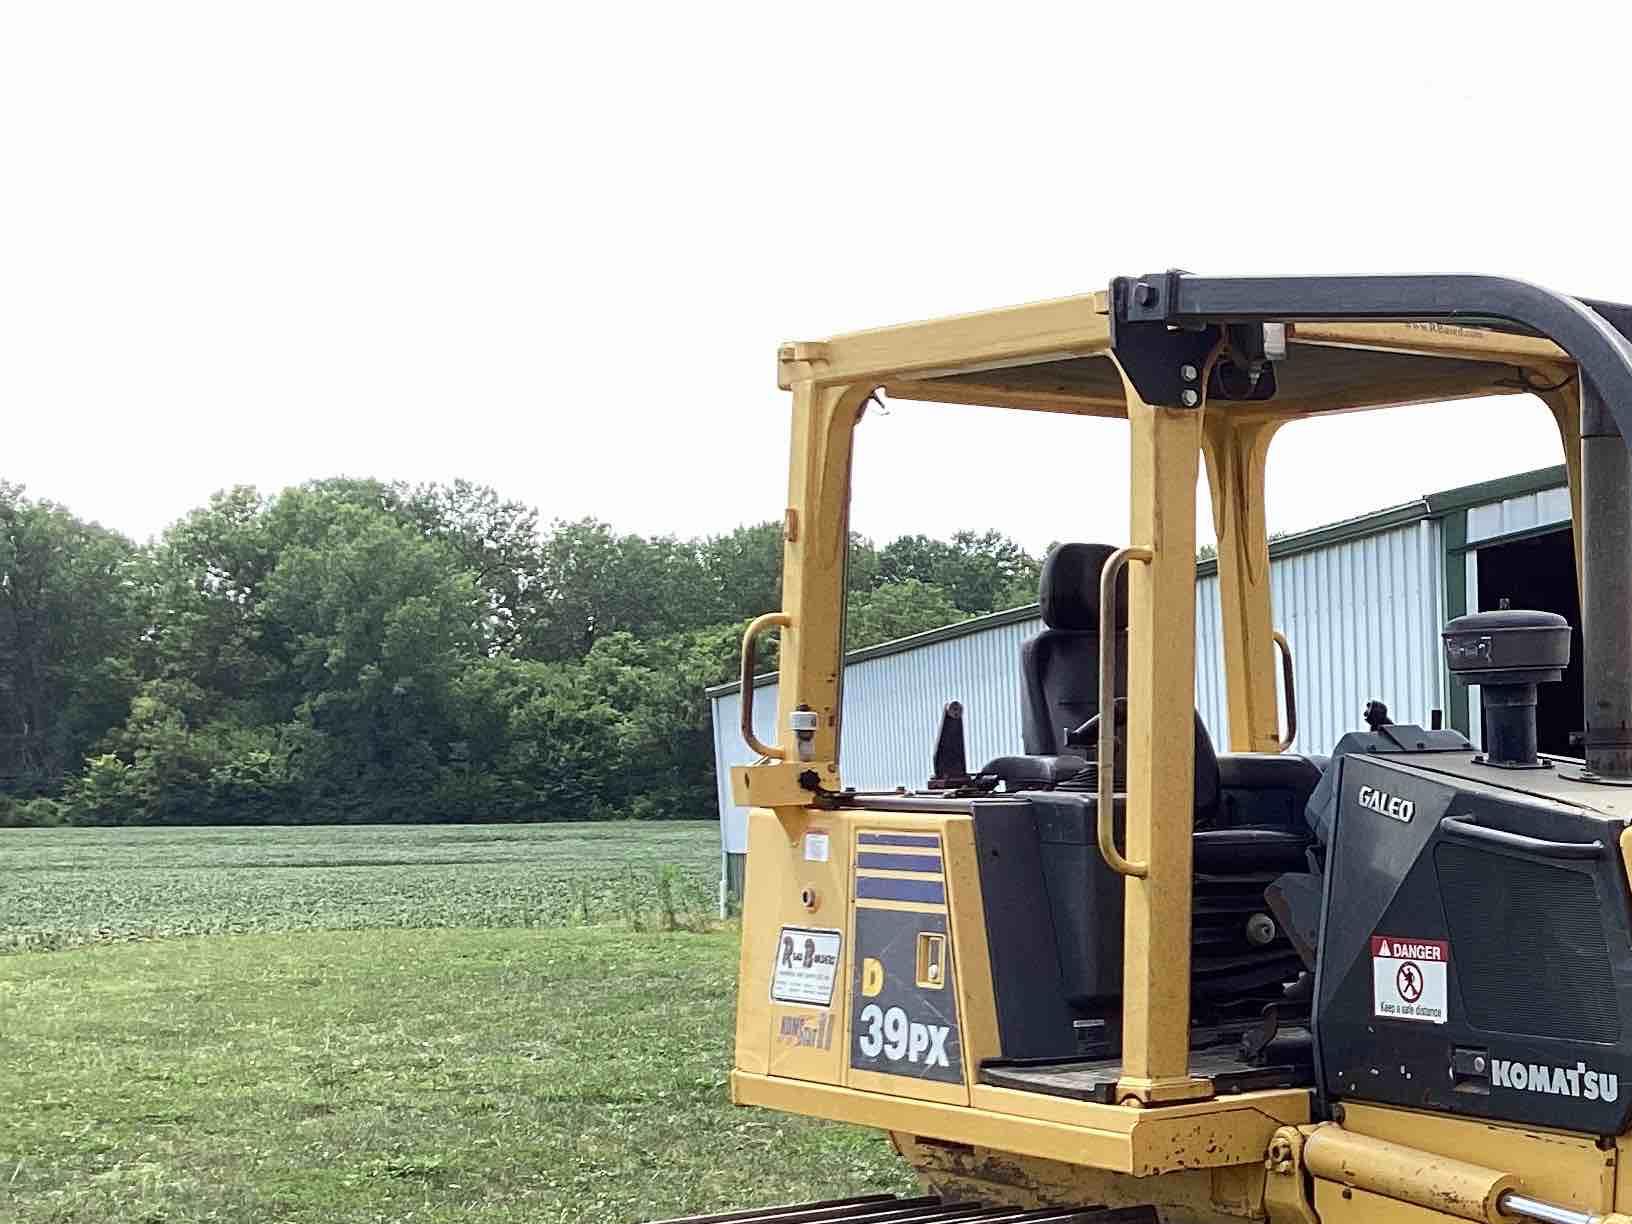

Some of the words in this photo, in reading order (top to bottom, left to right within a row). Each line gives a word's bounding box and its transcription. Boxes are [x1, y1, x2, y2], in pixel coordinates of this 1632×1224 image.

[1358, 785, 1414, 822] GALEO
[1392, 943, 1441, 960] DANGER
[862, 957, 884, 997] D
[859, 1003, 950, 1067] 39PX
[1491, 1059, 1618, 1103] KOMATSU
